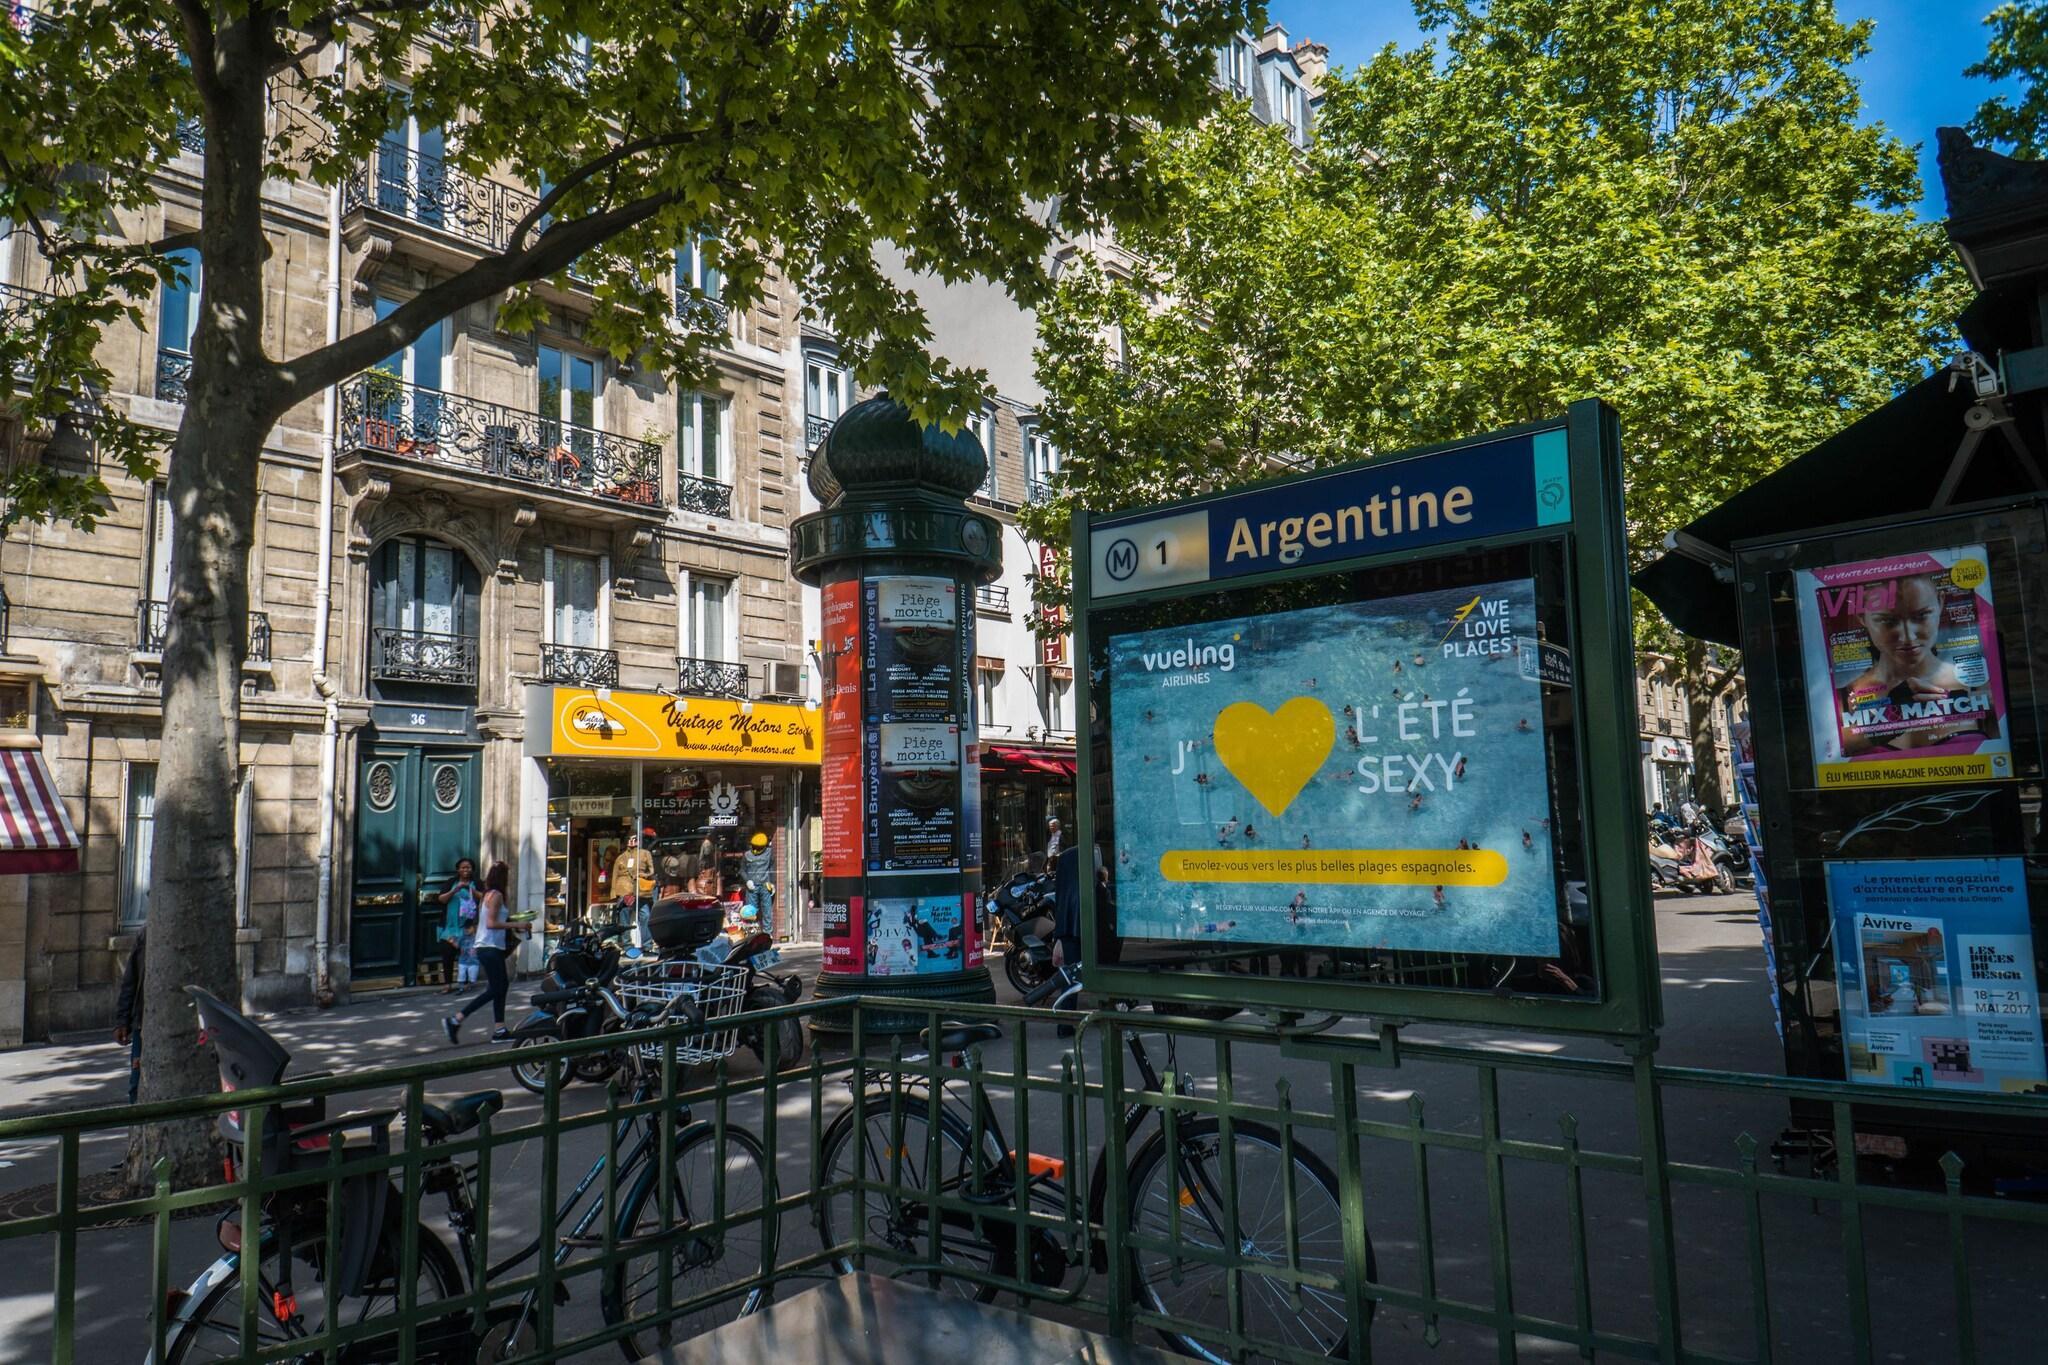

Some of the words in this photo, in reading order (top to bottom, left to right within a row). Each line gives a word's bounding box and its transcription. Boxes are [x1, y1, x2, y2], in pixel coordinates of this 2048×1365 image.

[1154, 540, 1168, 565] 1
[1226, 485, 1474, 564] Argentine
[1836, 568, 1862, 580] VENTE
[1863, 560, 1932, 577] ACTUELLEMENT
[901, 593, 940, 609] Piège
[1820, 580, 1899, 618] Vital
[895, 608, 945, 619] mortel
[1480, 600, 1509, 617] WE
[1464, 619, 1511, 638] LOVE
[867, 606, 878, 669] Bruyère
[1142, 638, 1235, 673] vueling
[867, 672, 877, 691] La
[1162, 673, 1210, 688] AIRLINES
[661, 699, 723, 736] Vintage
[730, 713, 782, 734] Motors
[1356, 704, 1379, 744] L'
[1399, 687, 1477, 742] ÉTÉ
[1842, 705, 1889, 728] MIX
[1900, 694, 1992, 720] MATCH
[410, 713, 426, 726] 36
[683, 742, 796, 757] www.vintage-motors.net
[903, 736, 943, 750] Piège
[896, 749, 946, 761] mortel
[1171, 739, 1195, 776] J'
[1358, 751, 1463, 796] SEXY
[1826, 771, 1841, 783] ÉLU
[1842, 769, 1881, 782] MEILLEUR
[1882, 767, 1927, 780] MAGAZINE
[1928, 764, 1964, 778] PASSION
[1967, 763, 1986, 776] 2017
[869, 750, 880, 813] Bruyère
[644, 798, 707, 809] BELSTAFF
[709, 816, 738, 826] Belstaff
[869, 818, 878, 838] La
[1182, 858, 1249, 871] Envolez-vous
[1251, 861, 1275, 871] vers
[1277, 858, 1292, 871] les
[1295, 859, 1318, 874] plus
[1320, 859, 1356, 872] belles
[1358, 860, 1398, 876] plages
[1401, 860, 1477, 876] espagnoles.
[1853, 884, 1945, 894] d'architecture
[1948, 886, 1964, 894] en
[1967, 885, 2014, 894] France
[1864, 875, 1879, 884] Le
[1881, 875, 1930, 887] premier
[1934, 875, 2000, 887] magazine
[1930, 895, 1955, 903] Puces
[1971, 895, 2003, 905] Design
[1862, 913, 1913, 931] Àvivre
[1969, 946, 1995, 956] LES
[1970, 954, 2015, 964] PUCES
[1971, 963, 1989, 972] DU
[1972, 970, 2022, 980] DESIGN
[1974, 990, 1988, 1000] 18
[2007, 990, 2020, 1000] 21
[1976, 1003, 1999, 1013] MAI
[2003, 1003, 2031, 1014] 2017
